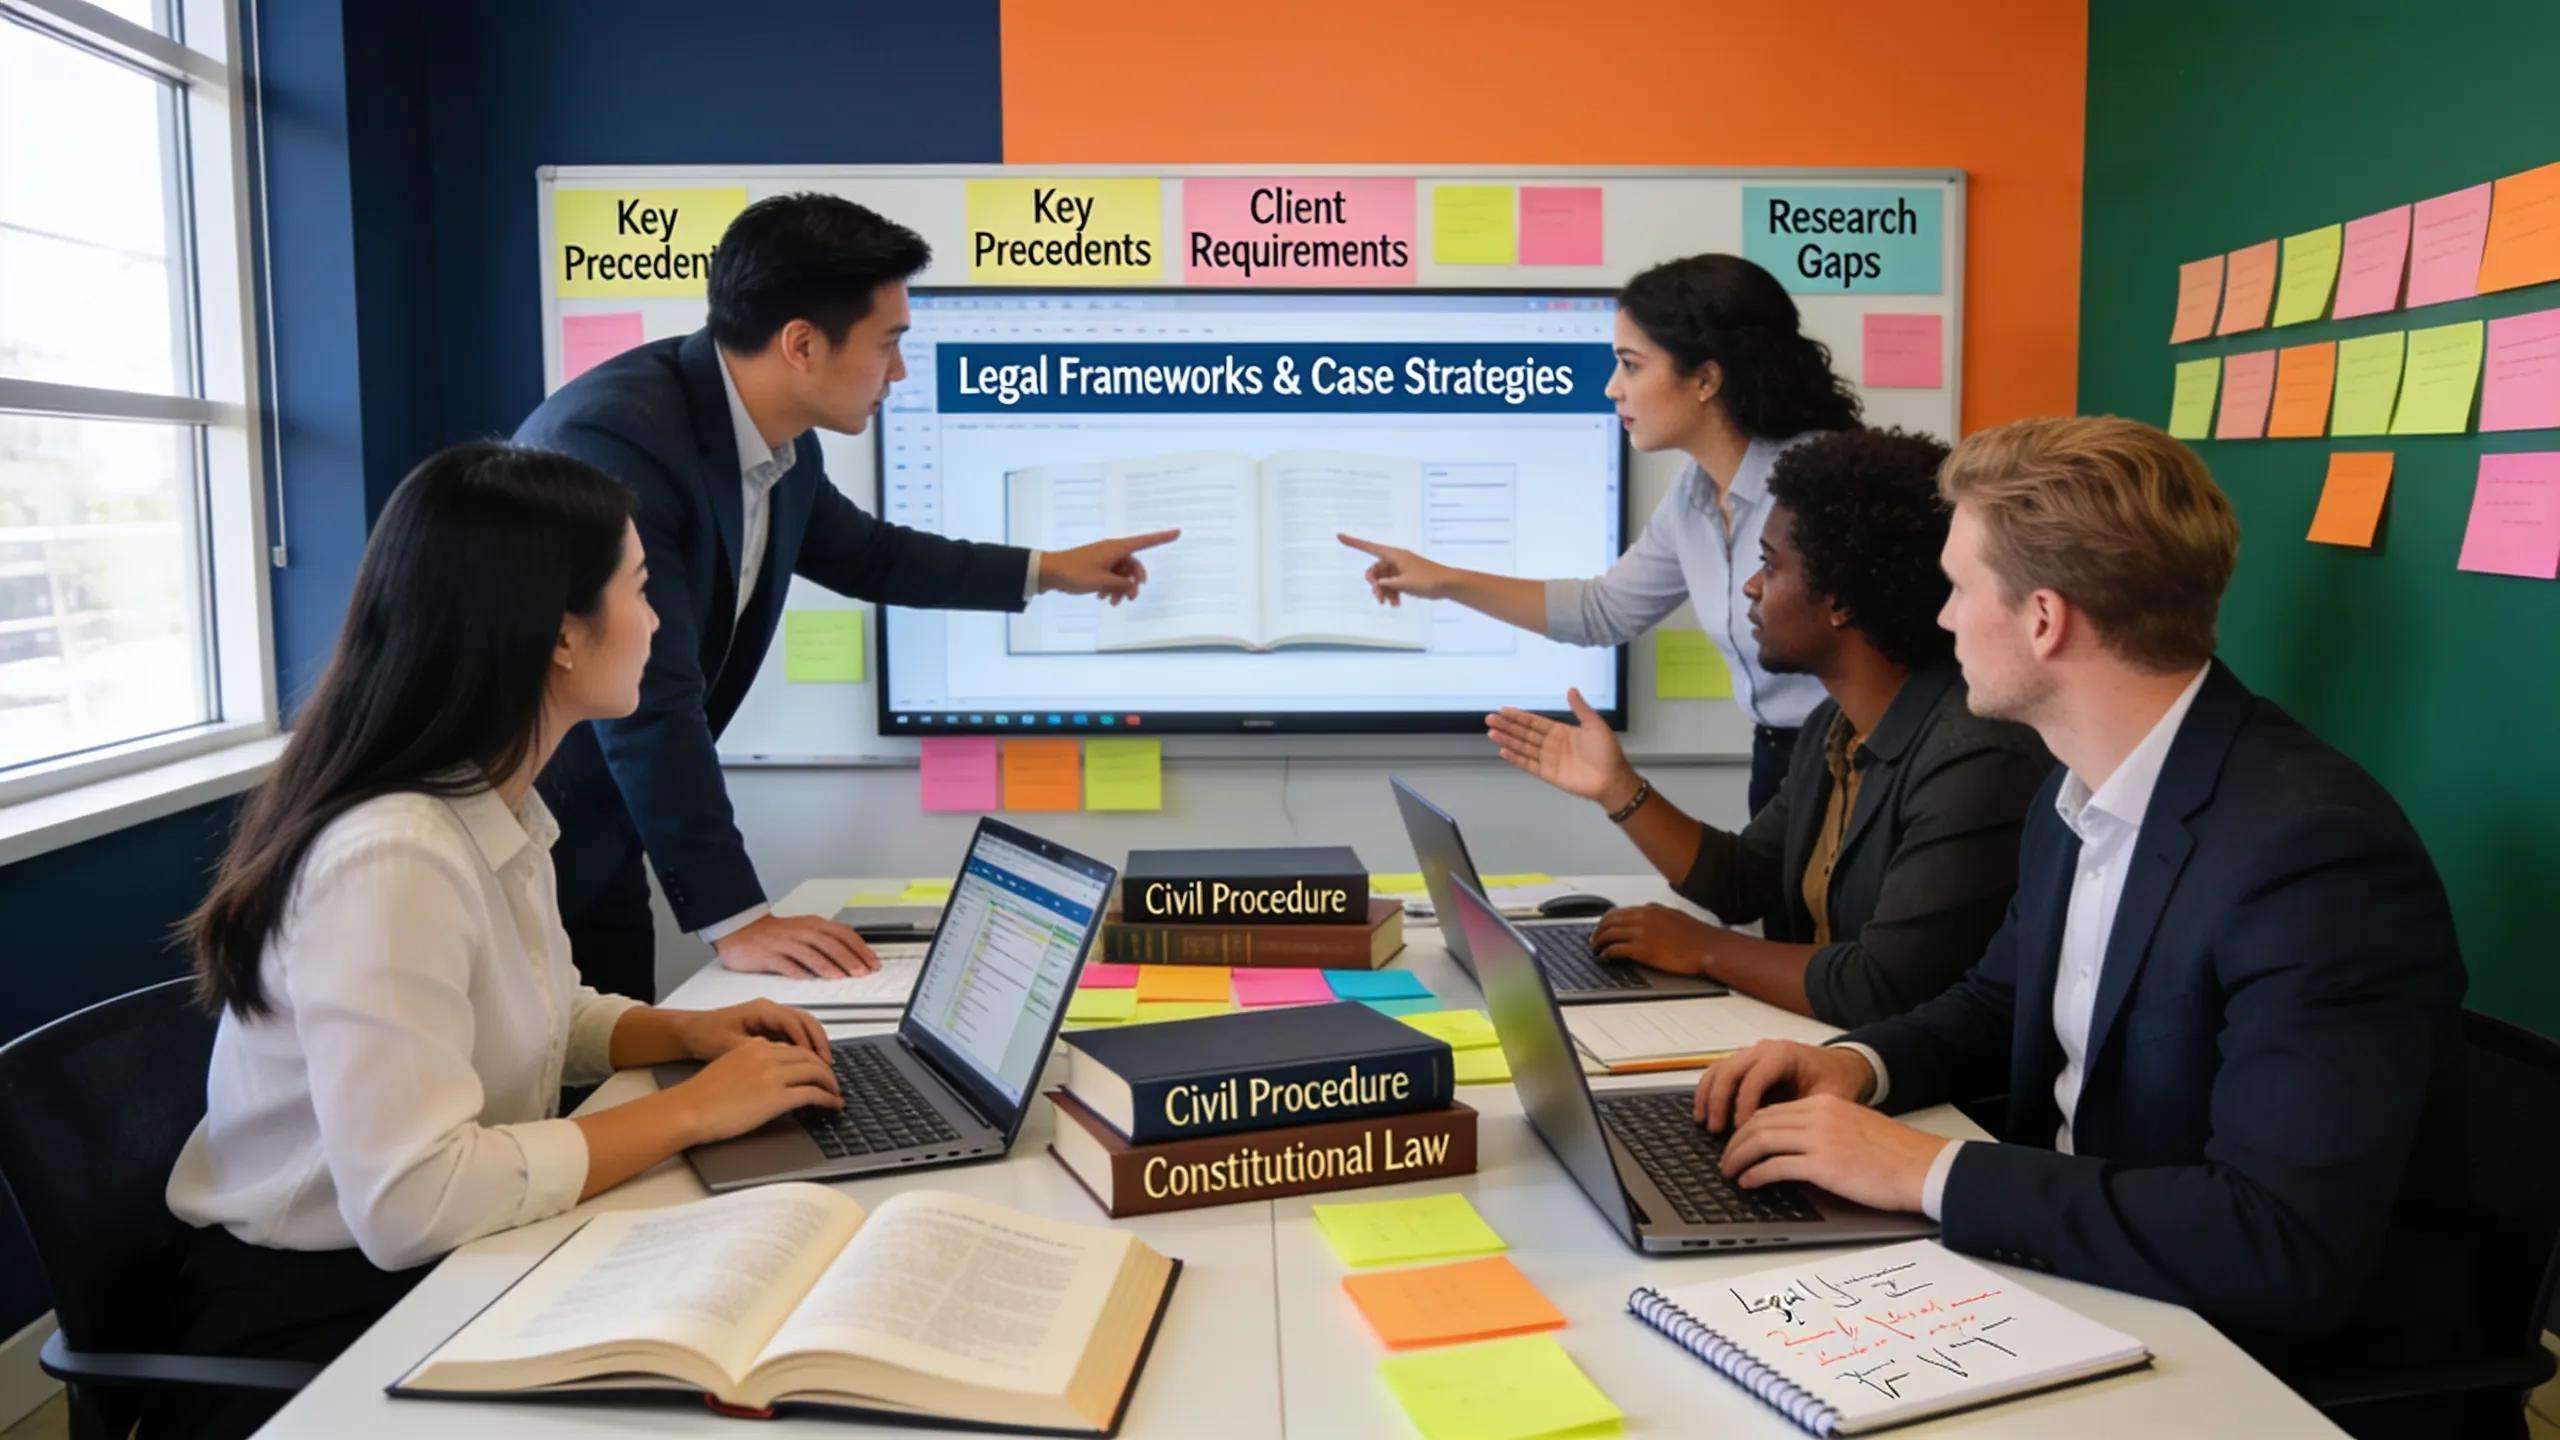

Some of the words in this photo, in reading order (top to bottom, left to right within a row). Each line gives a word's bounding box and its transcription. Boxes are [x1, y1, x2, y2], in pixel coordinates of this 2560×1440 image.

[618, 198, 678, 243] Key
[1034, 188, 1094, 231] Key
[1250, 186, 1347, 224] Client
[1769, 196, 1917, 235] Research
[564, 244, 717, 281] Preceden
[975, 231, 1151, 268] Precedents
[1191, 231, 1408, 278] Requirements
[1797, 243, 1881, 289] Gaps
[959, 354, 1048, 405] Legal
[1060, 355, 1263, 395] Frameworks
[1273, 355, 1302, 395] &
[1311, 356, 1395, 395] Case
[1404, 356, 1574, 405] Strategies
[1145, 880, 1203, 915] Civil
[1213, 880, 1347, 914] Procedure
[1165, 1078, 1238, 1126] Civil
[1249, 1065, 1409, 1117] Procedure
[1143, 1131, 1373, 1199] Constitutional
[1385, 1129, 1450, 1171] Law
